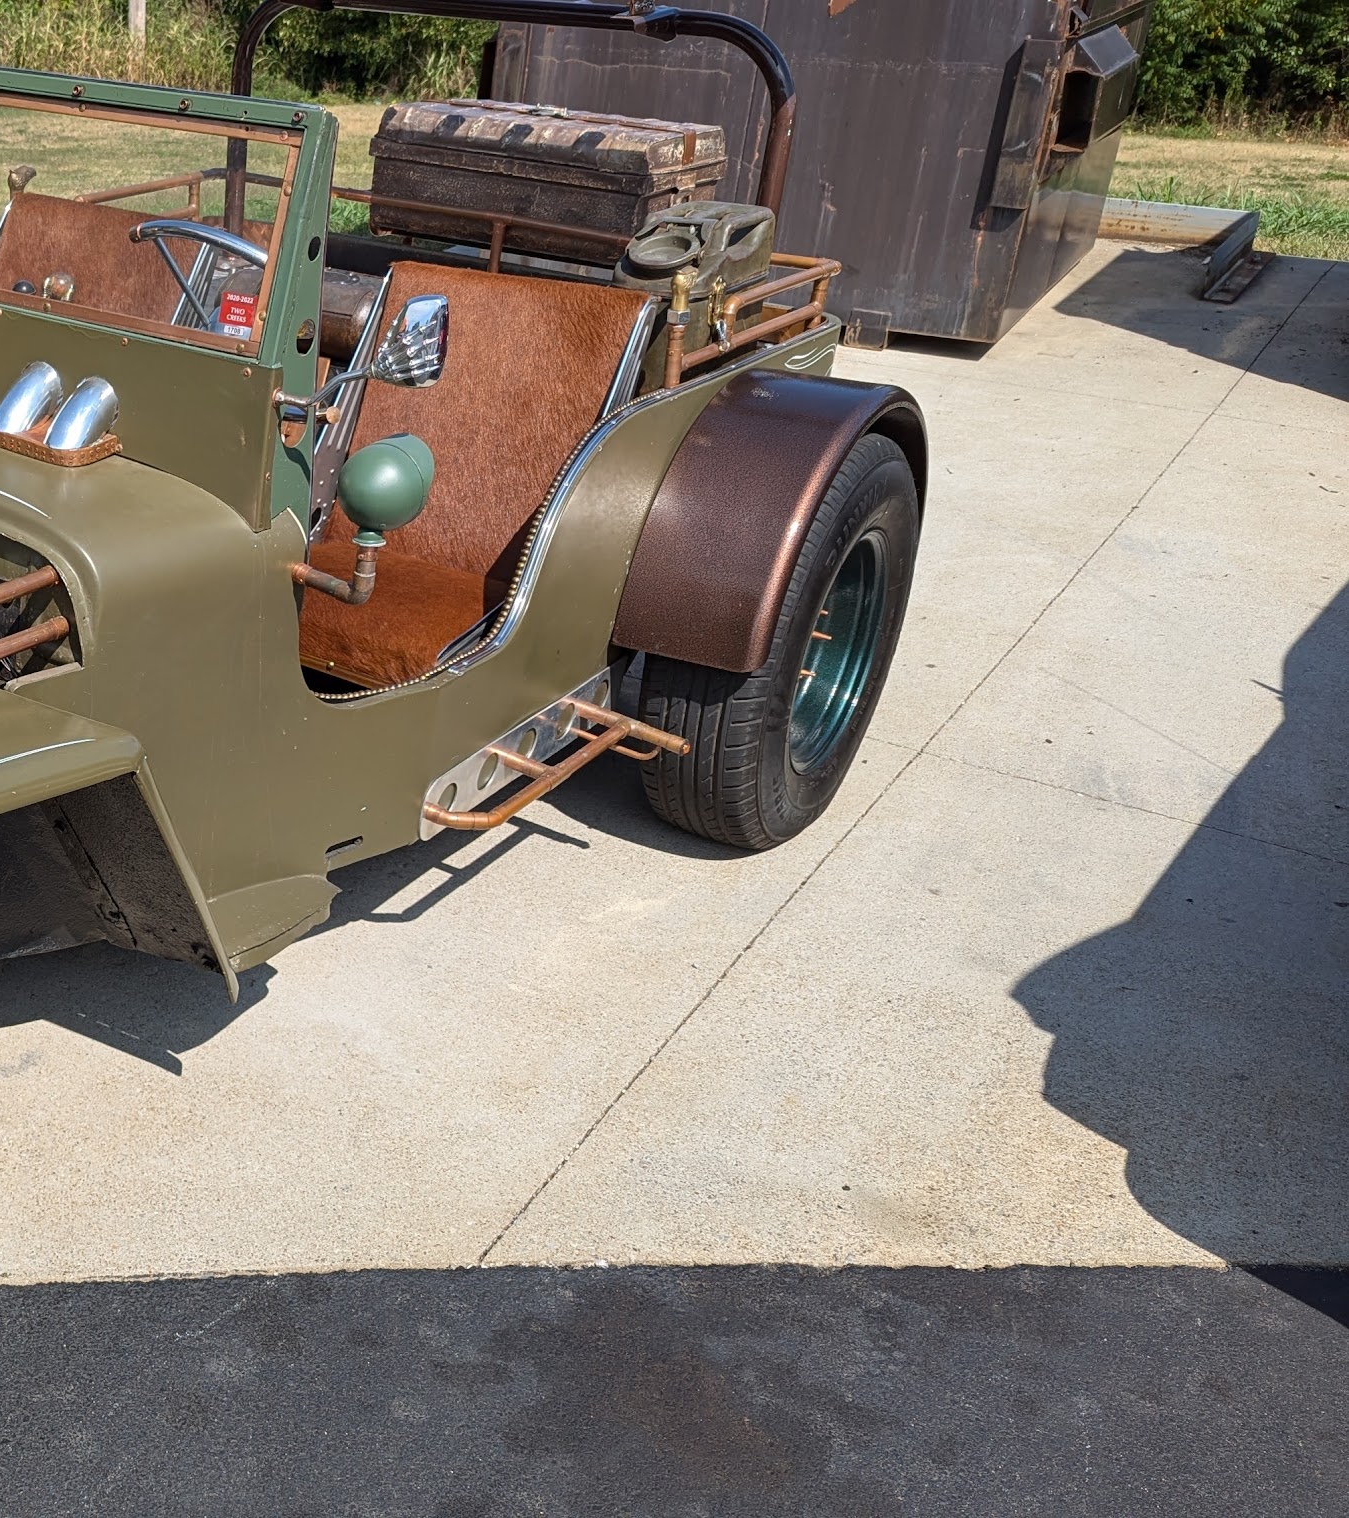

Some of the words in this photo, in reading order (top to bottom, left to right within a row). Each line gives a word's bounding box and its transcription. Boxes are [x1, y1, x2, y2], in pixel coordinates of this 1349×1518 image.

[227, 293, 254, 304] 2020-2022
[231, 306, 246, 316] TWO
[226, 314, 247, 323] CREEKS
[227, 326, 241, 335] 1708
